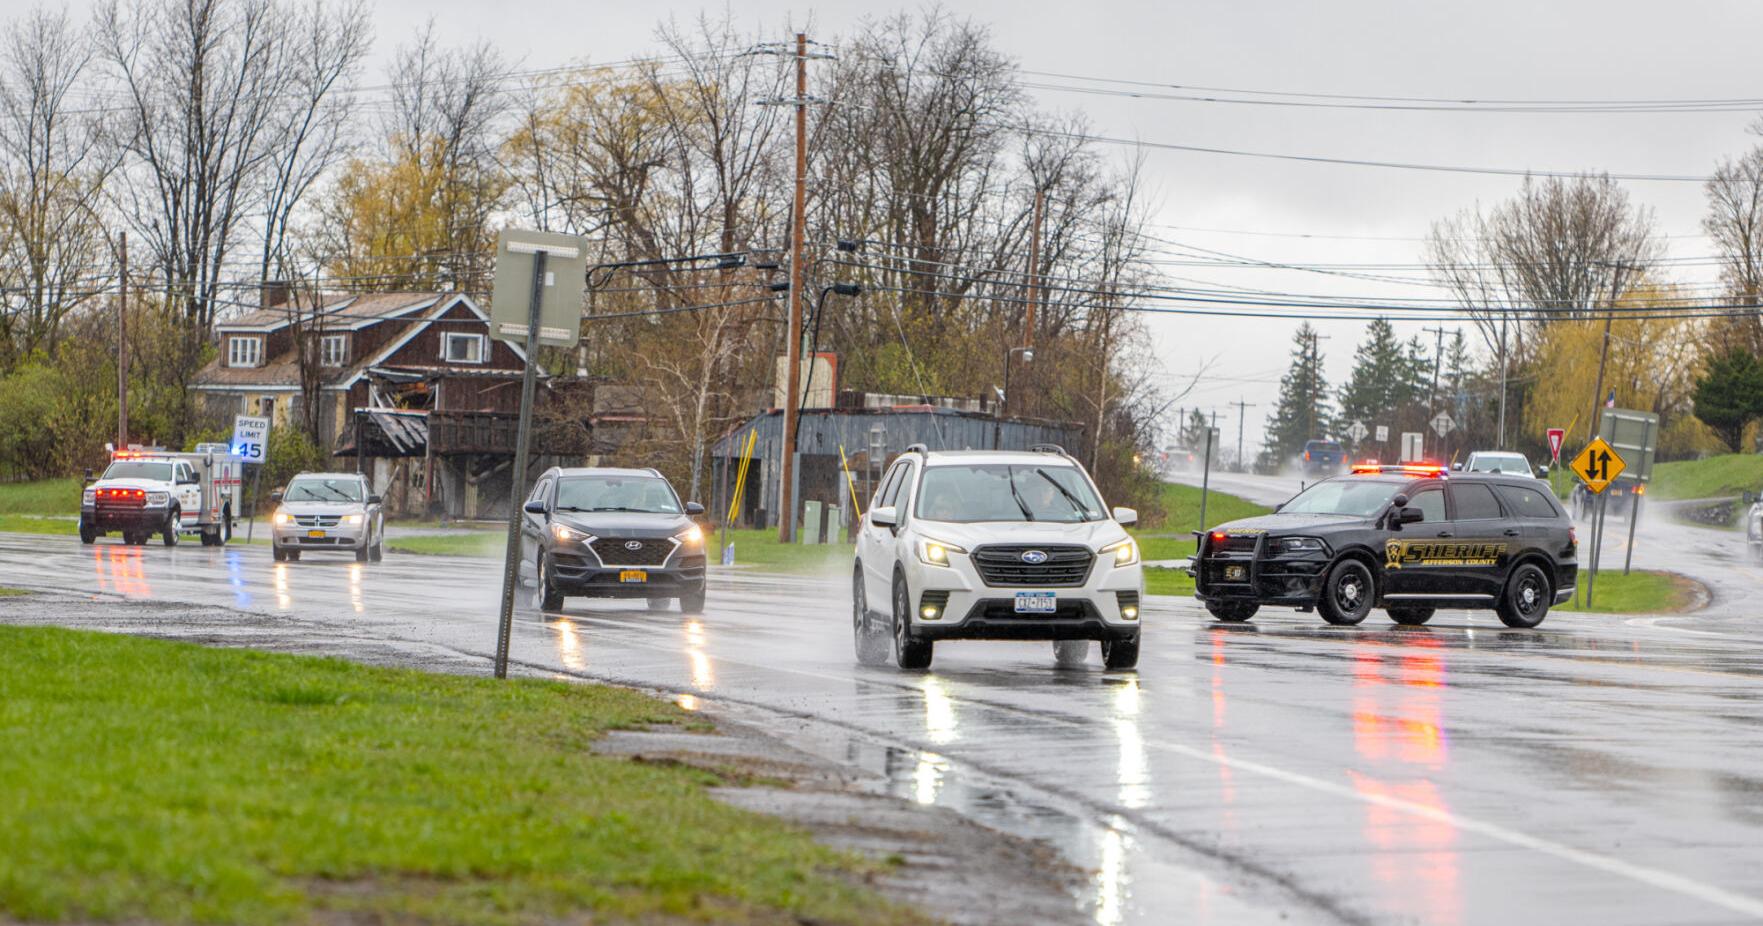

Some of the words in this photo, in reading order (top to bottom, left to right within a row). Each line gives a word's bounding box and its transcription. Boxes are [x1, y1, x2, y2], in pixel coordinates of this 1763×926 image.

[239, 420, 265, 428] SPEED
[239, 443, 261, 458] 45
[1403, 543, 1507, 563] SHERIFF
